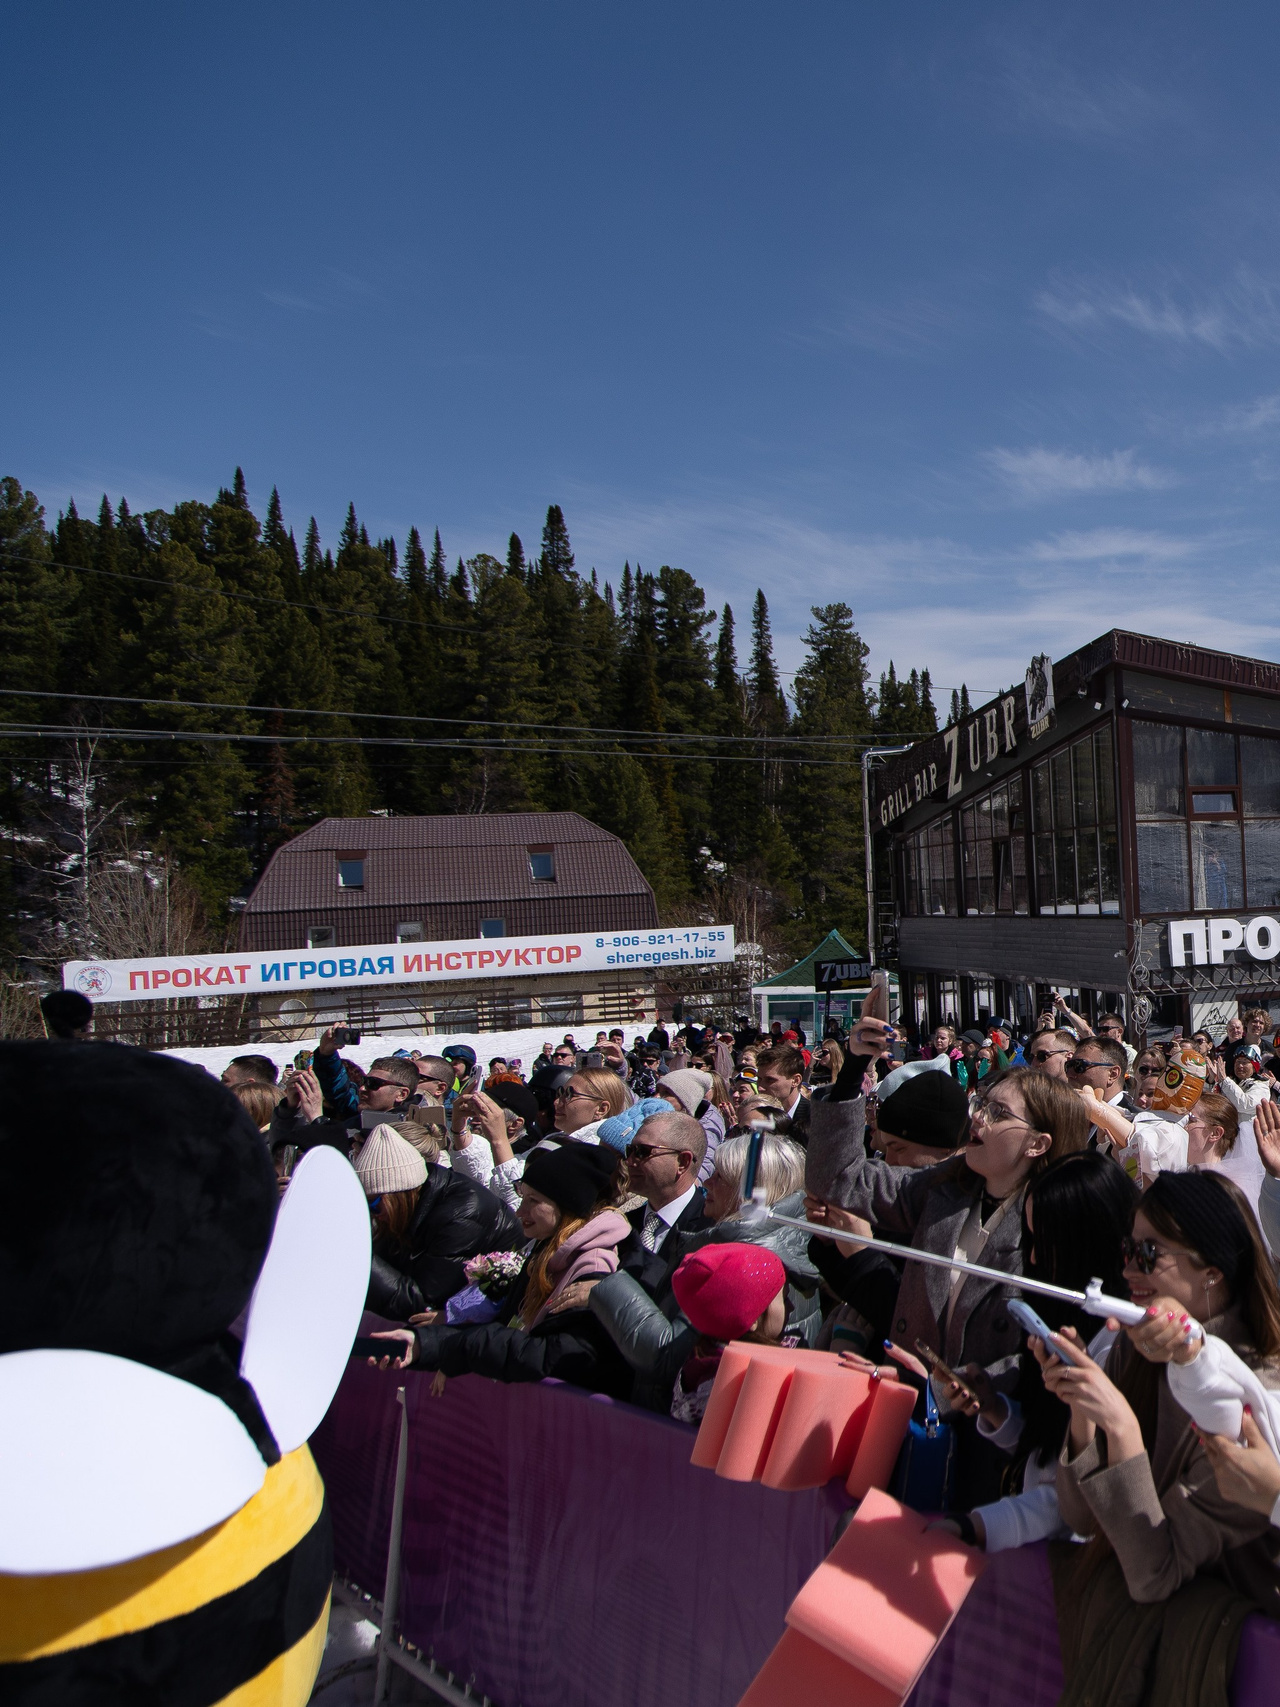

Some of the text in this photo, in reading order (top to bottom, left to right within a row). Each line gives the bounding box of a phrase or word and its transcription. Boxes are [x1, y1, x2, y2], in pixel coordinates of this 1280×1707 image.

[943, 695, 1018, 799] ZUBR
[880, 762, 937, 827] GRILL BAR
[595, 931, 726, 949] 8-906-921-17-55
[606, 946, 717, 965] sheregesh.biz
[129, 945, 582, 991] ПРОКАТ ИГРОВАЯ ИНСТРУКТОР
